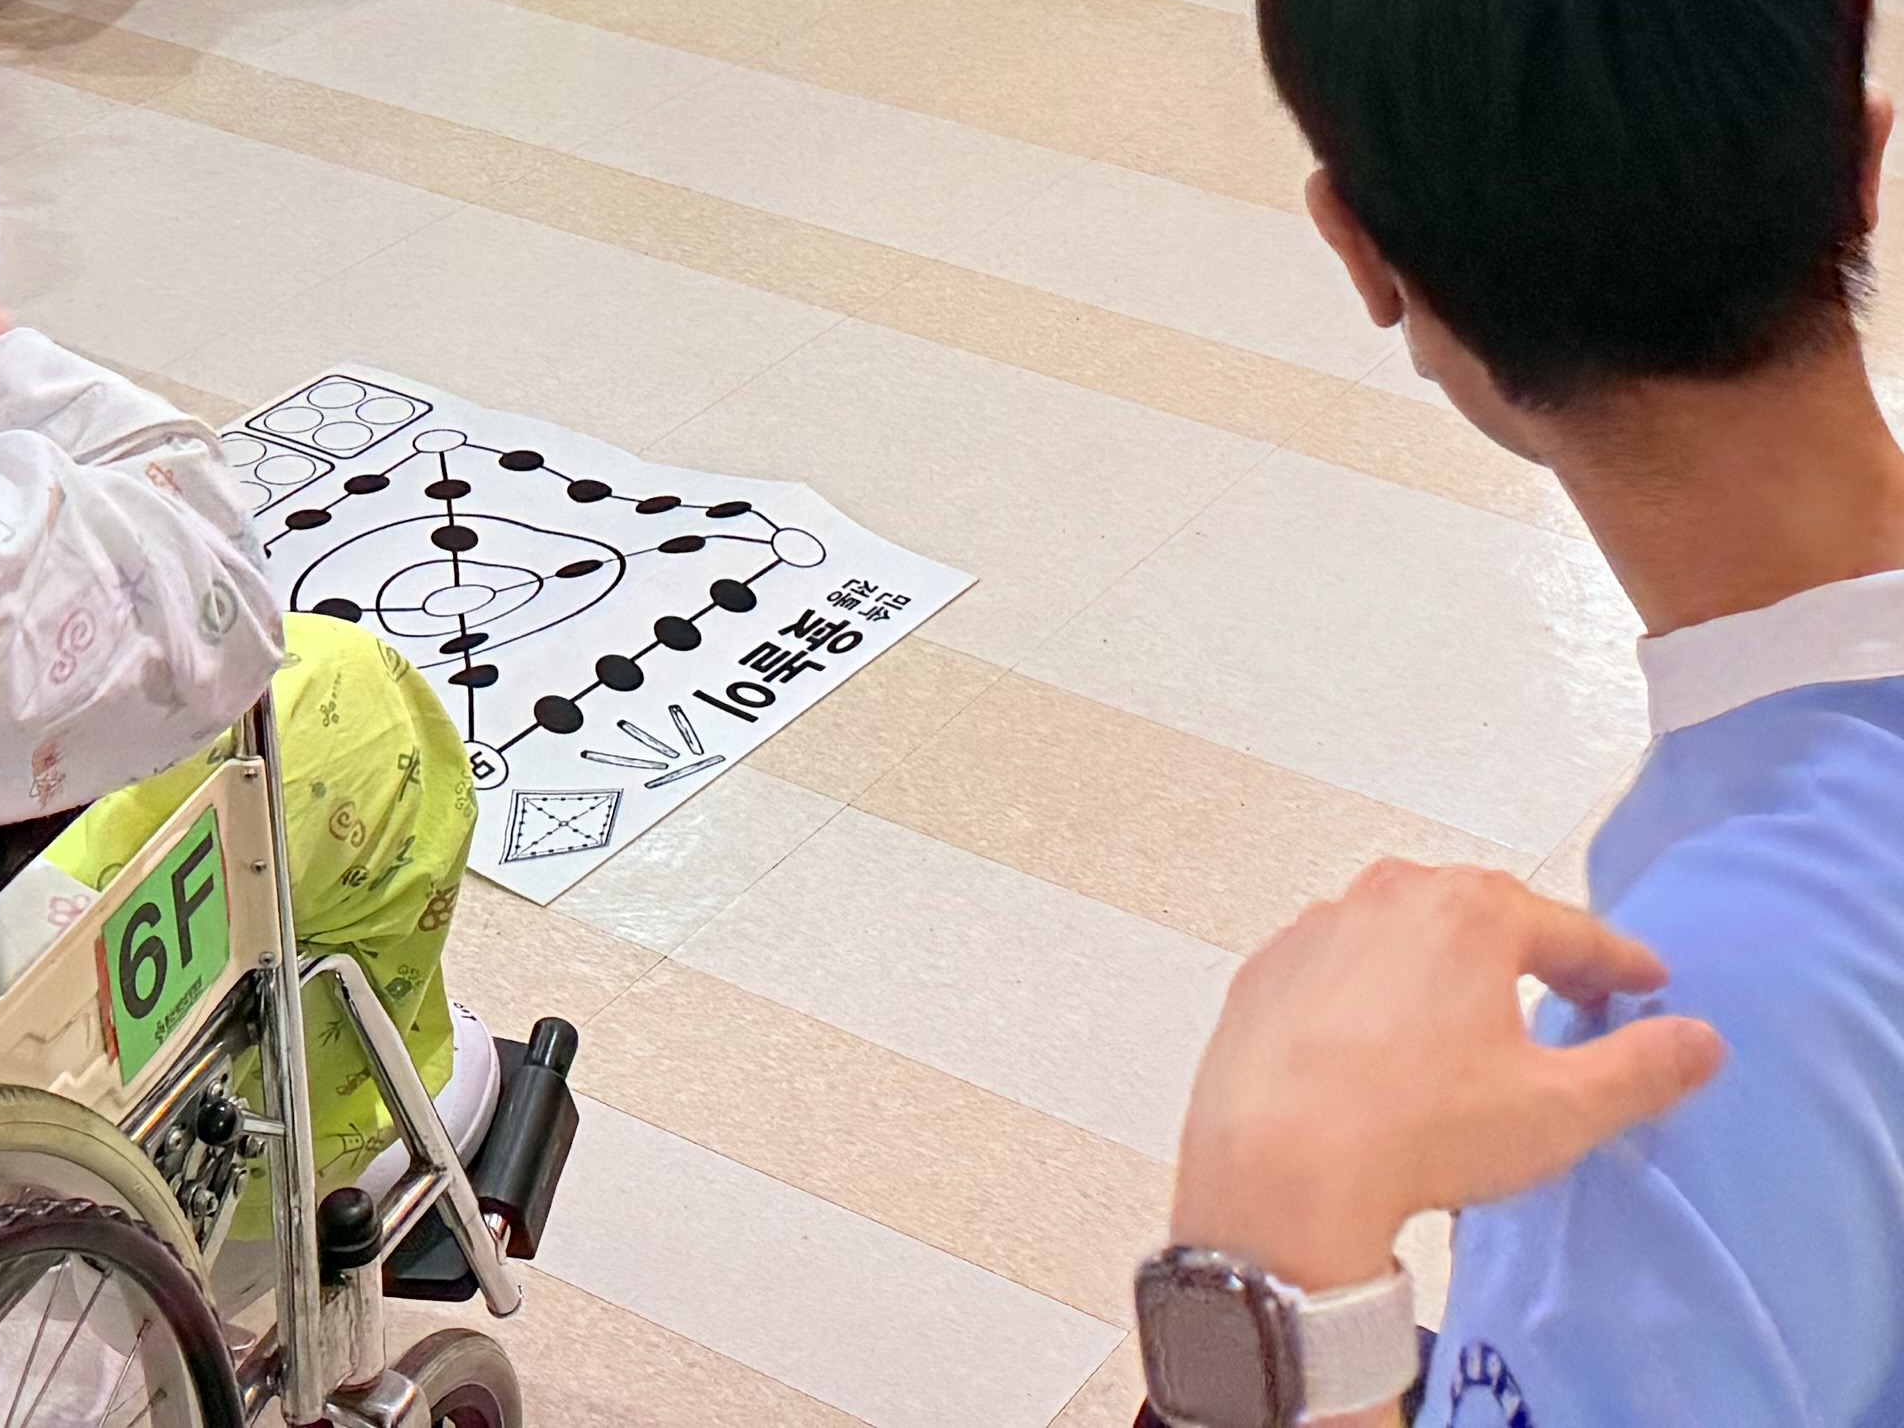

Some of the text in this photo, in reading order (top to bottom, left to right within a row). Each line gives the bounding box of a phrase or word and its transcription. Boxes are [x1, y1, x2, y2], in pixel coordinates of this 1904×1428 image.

[826, 578, 882, 612] 전통
[865, 594, 913, 624] 민속
[694, 607, 864, 724] 윷놀이
[119, 831, 214, 1019] 6F
